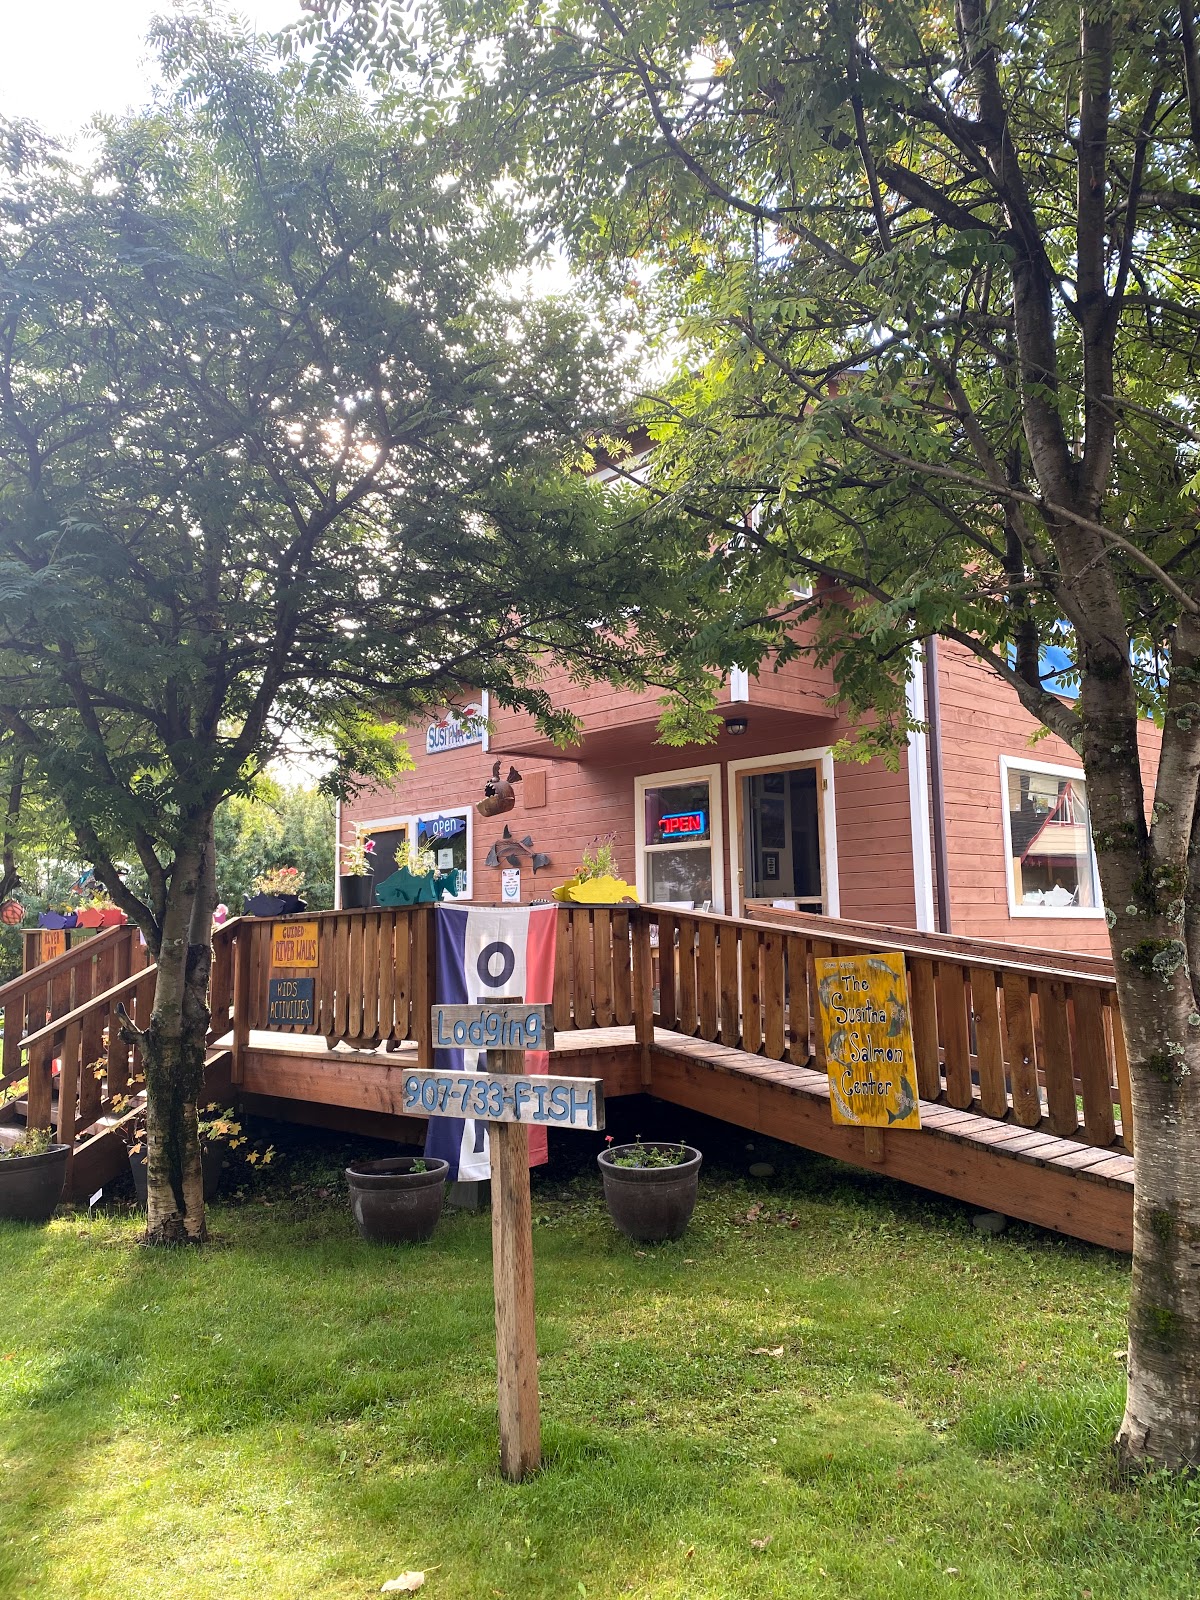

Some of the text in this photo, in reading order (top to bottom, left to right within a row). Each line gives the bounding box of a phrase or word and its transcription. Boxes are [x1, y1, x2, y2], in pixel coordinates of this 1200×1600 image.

[658, 815, 700, 832] OPEN
[275, 939, 316, 961] RIVER WALKS
[840, 974, 870, 992] The
[269, 998, 310, 1019] ACTIVITIES
[830, 991, 887, 1025] Susitna
[437, 1009, 542, 1049] Lodging
[849, 1031, 904, 1063] Salmon
[841, 1070, 893, 1097] Center
[405, 1075, 594, 1128] 907-733-FISH
